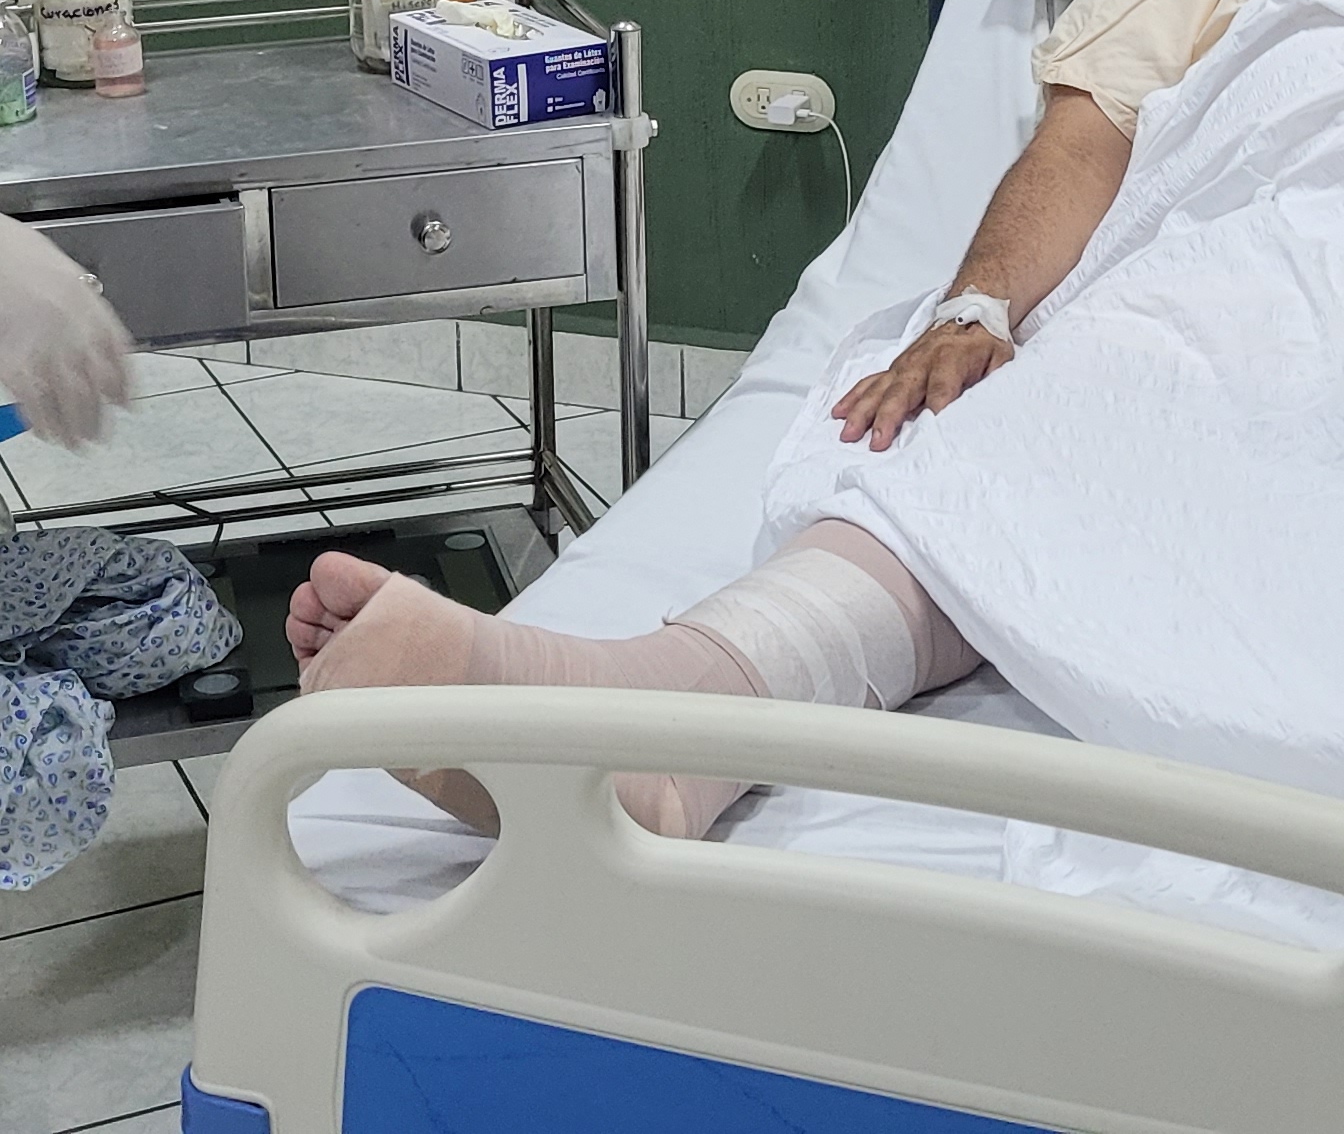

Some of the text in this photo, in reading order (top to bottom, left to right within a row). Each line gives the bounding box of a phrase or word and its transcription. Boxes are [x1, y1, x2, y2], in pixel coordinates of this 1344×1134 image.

[40, 0, 120, 19] Curaciones
[493, 66, 507, 126] DERMA
[506, 82, 518, 123] FLEX
